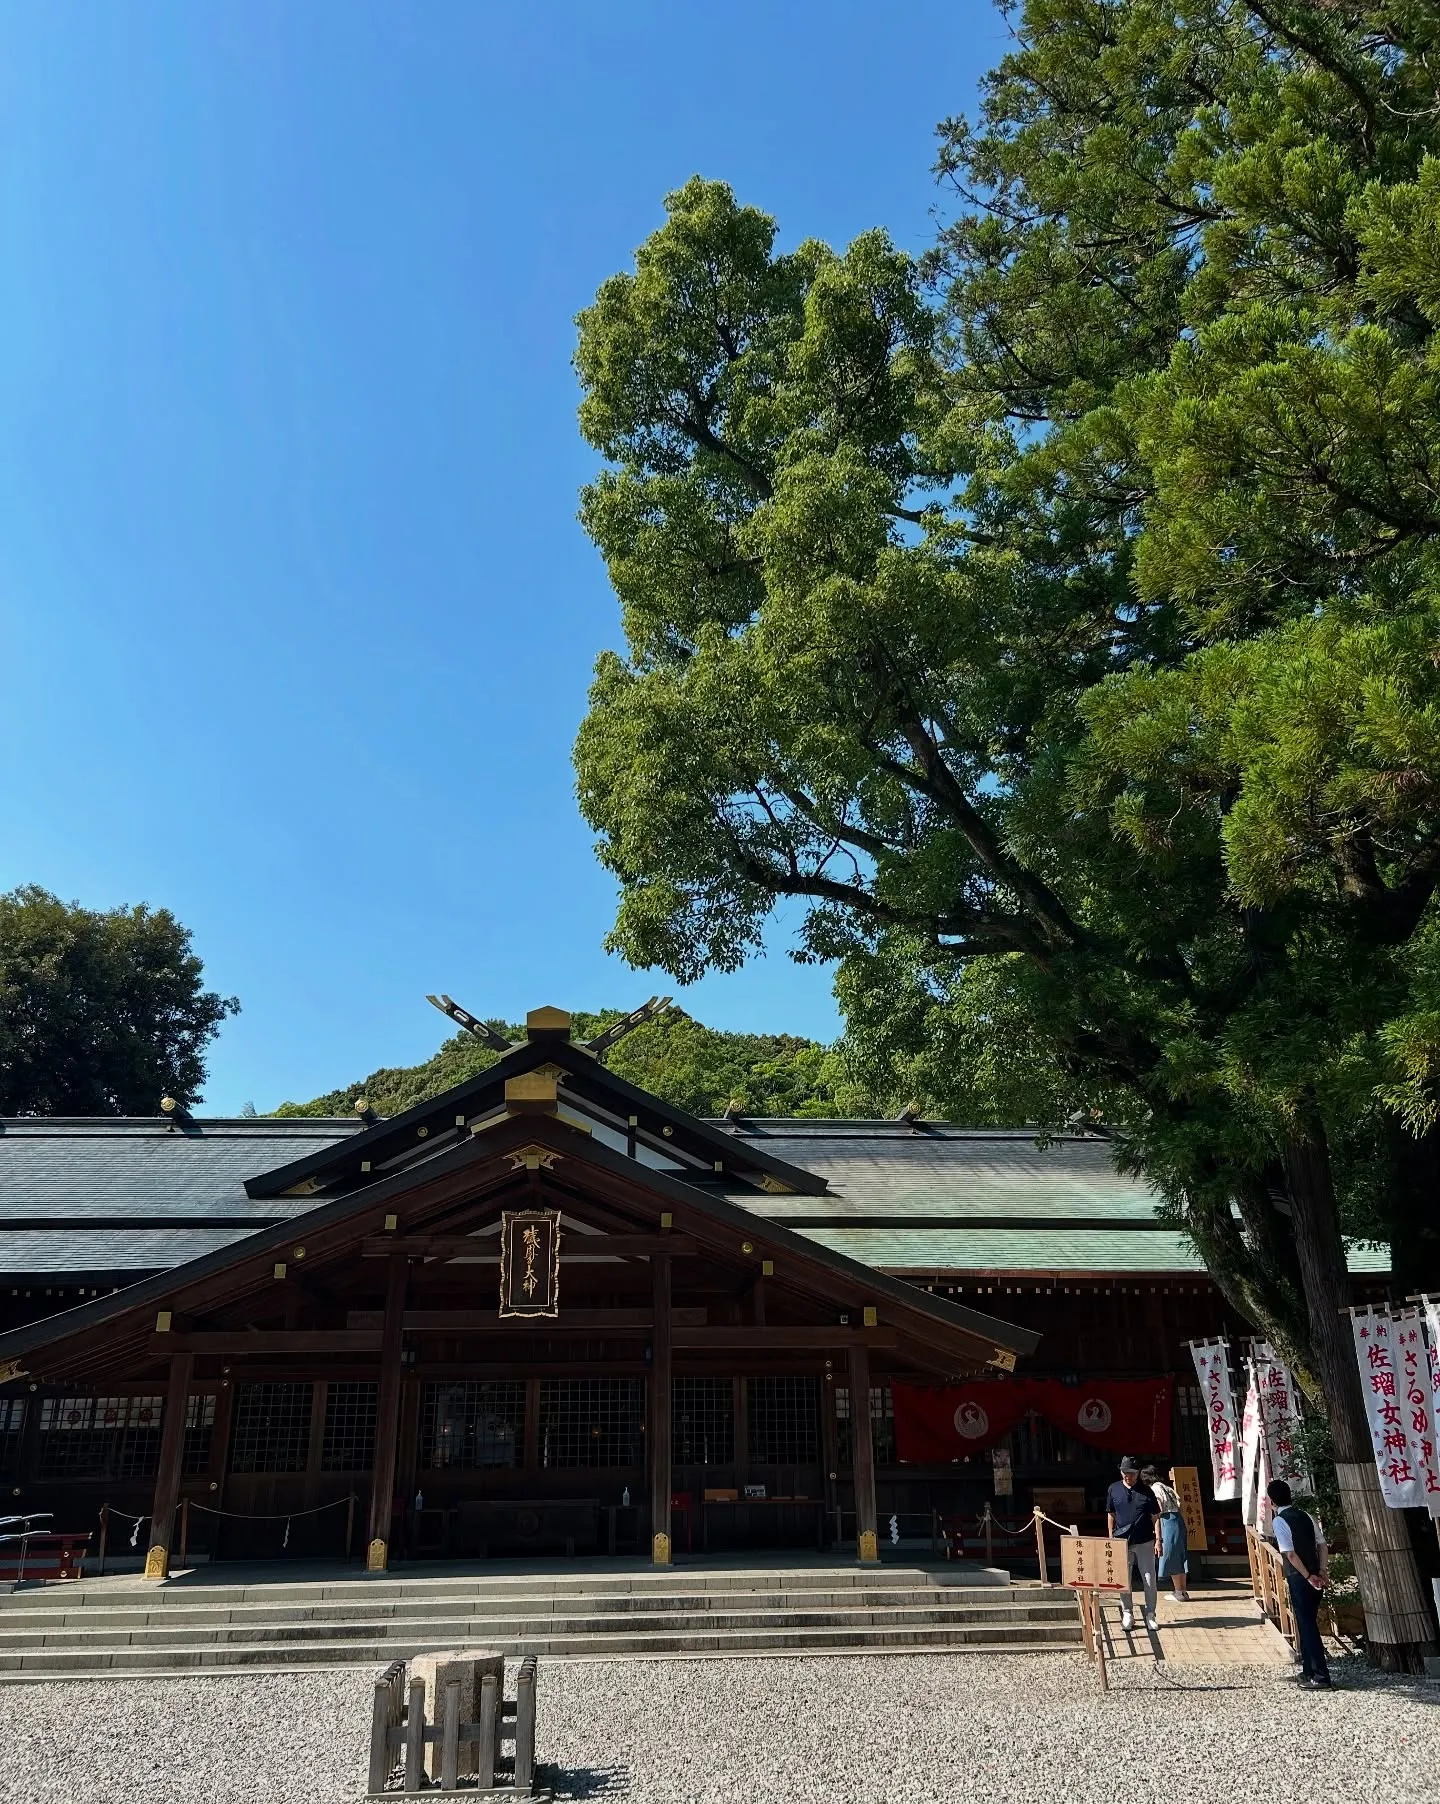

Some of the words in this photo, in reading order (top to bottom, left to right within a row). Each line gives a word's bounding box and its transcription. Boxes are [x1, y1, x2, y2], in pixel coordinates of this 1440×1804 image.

[1360, 1324, 1387, 1339] 奉納
[1399, 1330, 1417, 1346] 奉納
[1199, 1353, 1221, 1367] 奉納
[1367, 1343, 1416, 1486] 佐瑠女神社
[1208, 1369, 1238, 1481] さるめ神社
